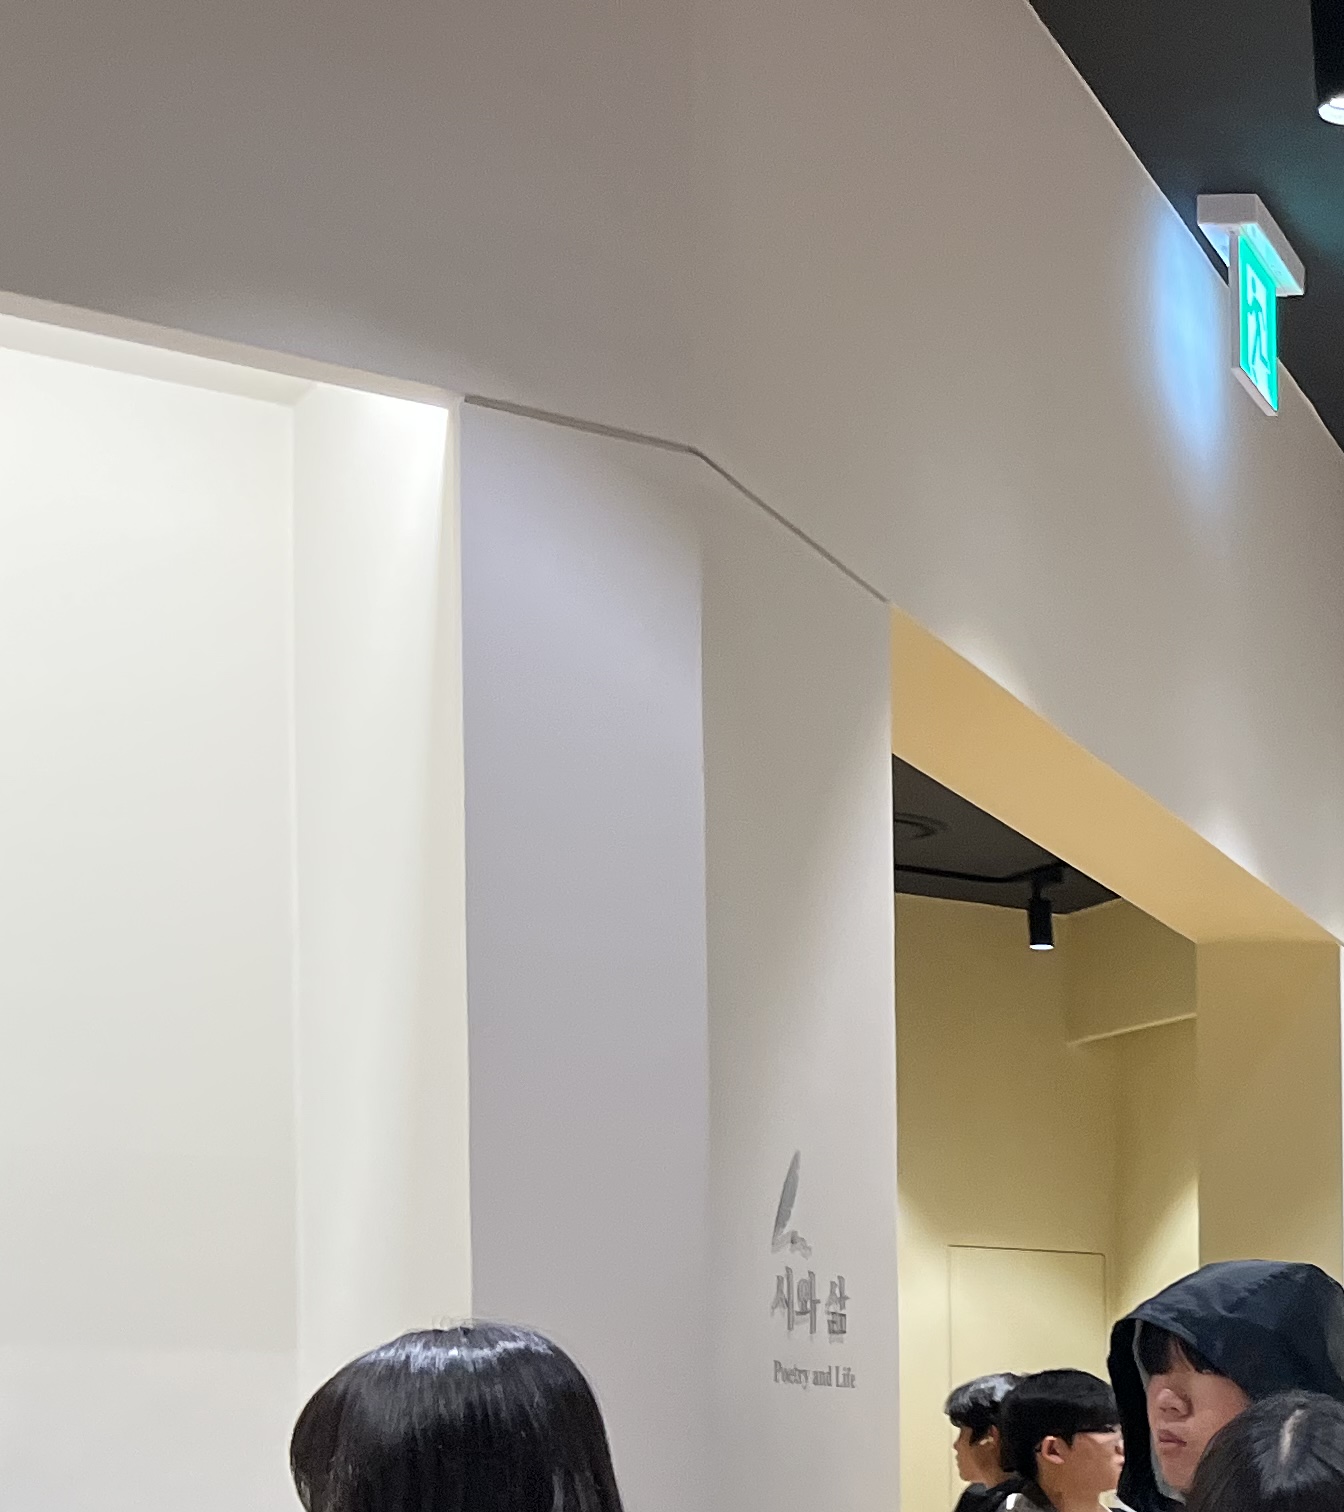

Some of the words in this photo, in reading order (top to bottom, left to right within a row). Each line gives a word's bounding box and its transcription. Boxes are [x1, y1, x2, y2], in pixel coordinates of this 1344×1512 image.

[771, 1265, 821, 1335] 시와
[773, 1359, 808, 1388] Poetry
[812, 1366, 832, 1387] and
[835, 1365, 856, 1388] Life
